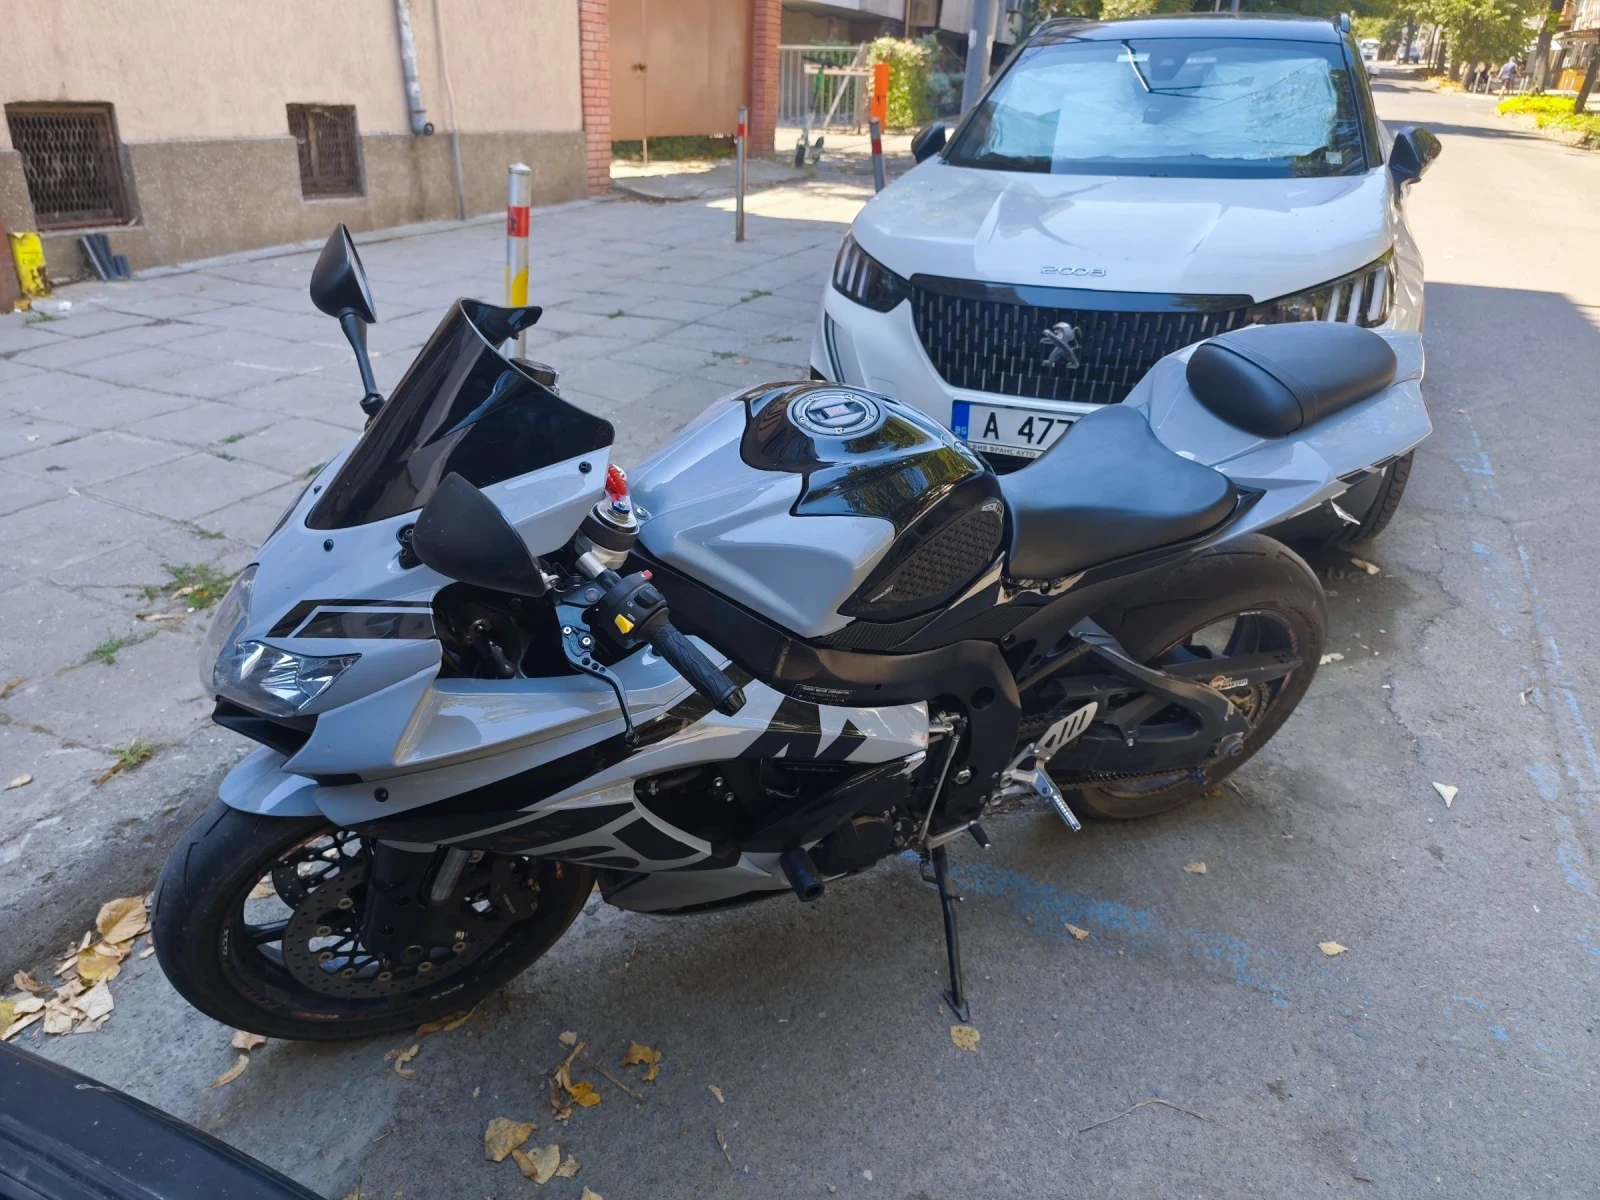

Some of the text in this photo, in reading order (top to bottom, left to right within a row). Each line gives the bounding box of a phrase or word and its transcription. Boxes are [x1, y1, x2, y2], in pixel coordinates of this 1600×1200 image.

[1040, 266, 1106, 278] 2008
[955, 425, 967, 436] BG
[982, 411, 999, 440] A
[971, 443, 987, 451] ФИЯ
